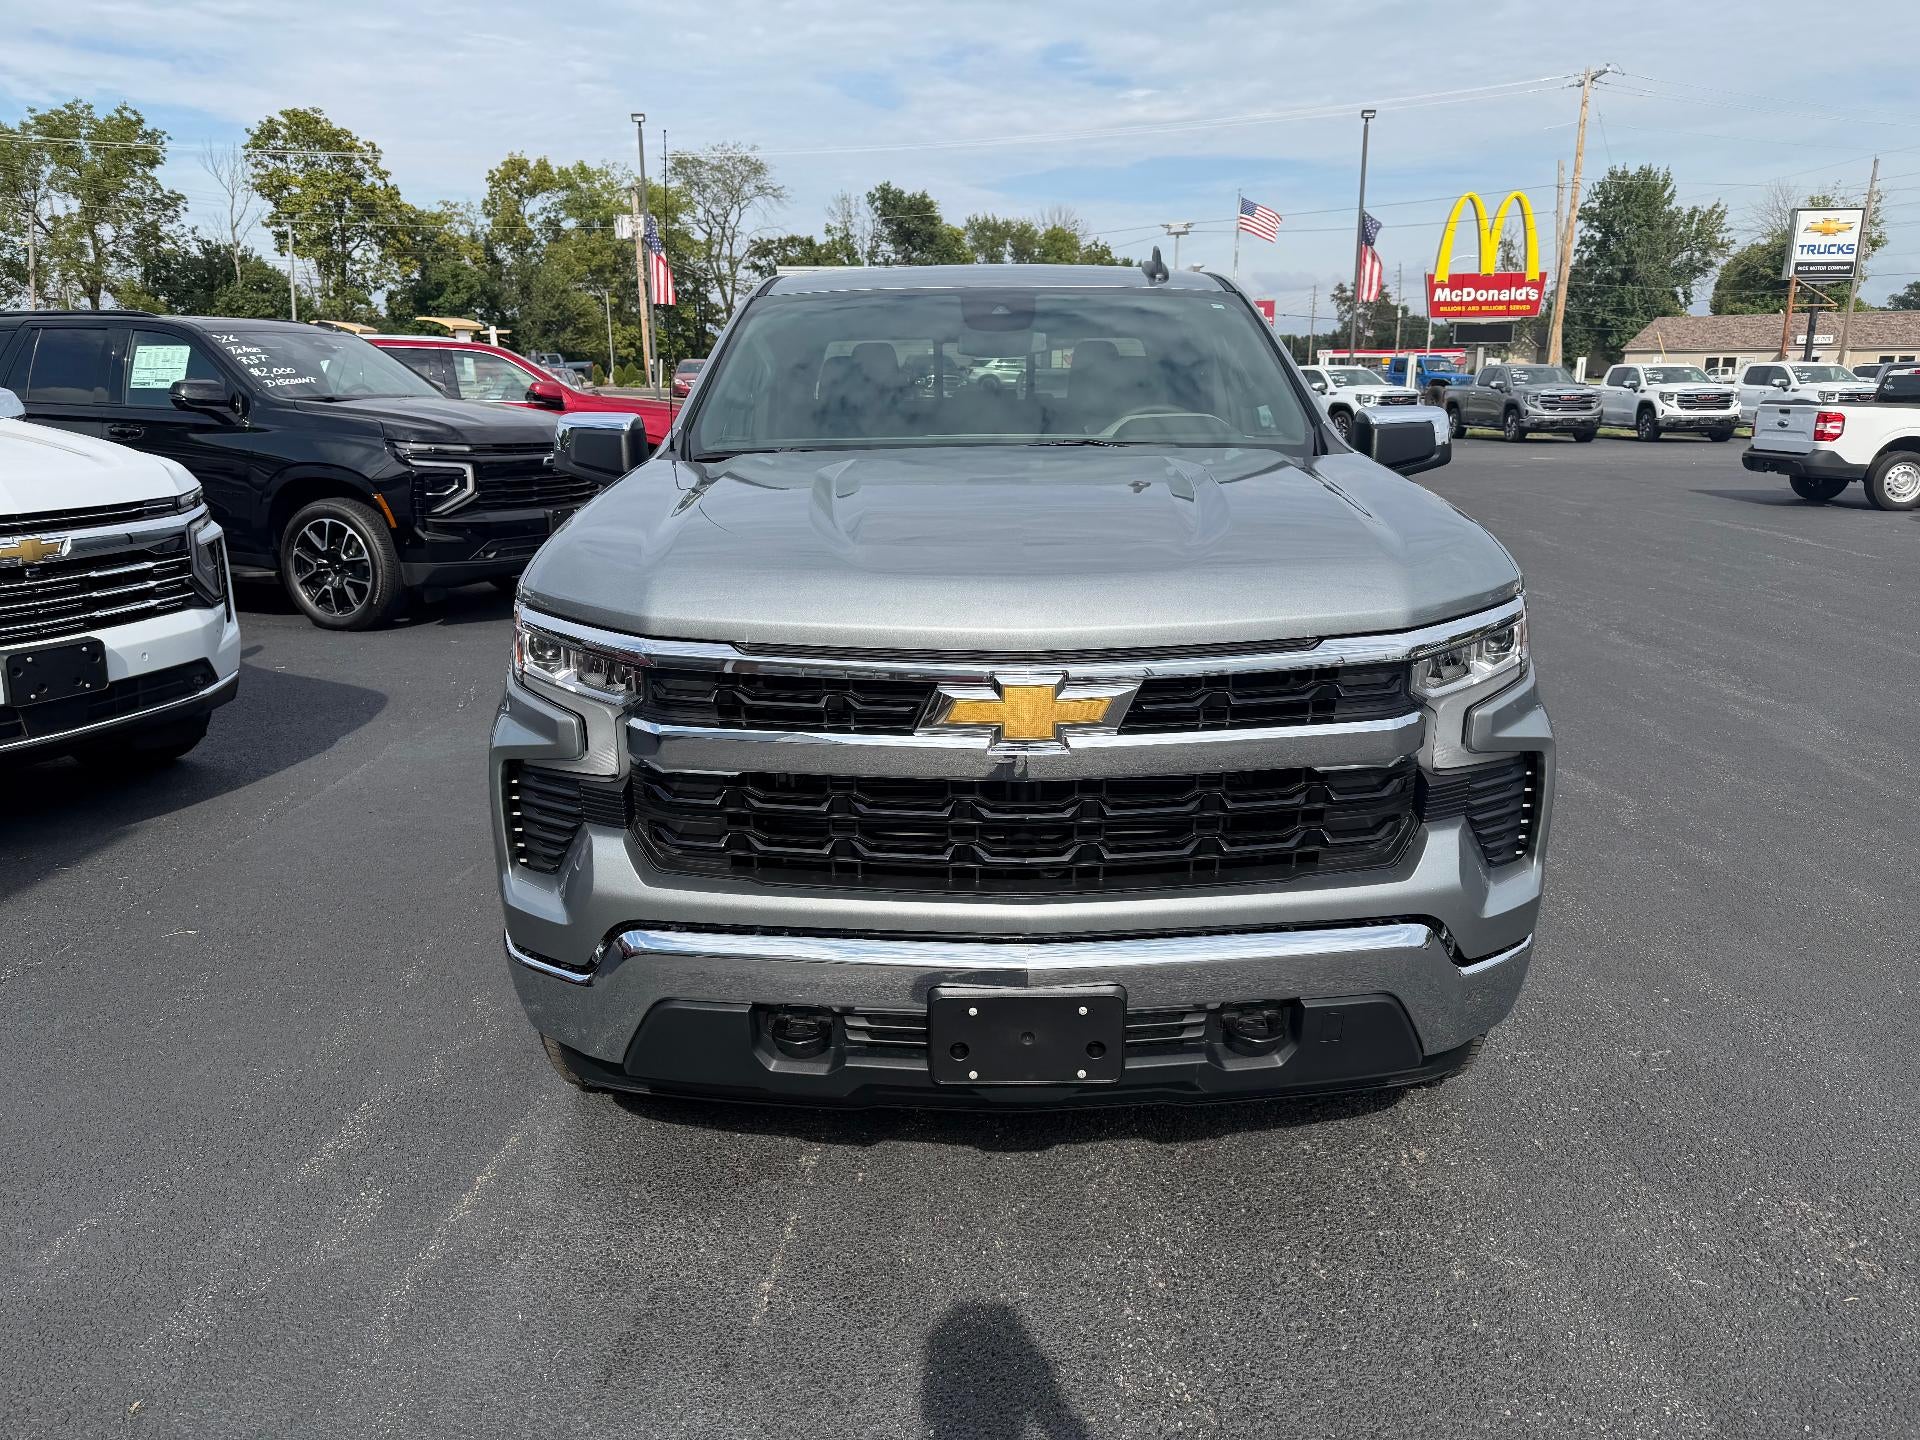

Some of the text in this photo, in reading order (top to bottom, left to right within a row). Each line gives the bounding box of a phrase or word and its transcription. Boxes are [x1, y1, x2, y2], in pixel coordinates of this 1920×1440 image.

[1798, 243, 1856, 255] TRUCKS
[1433, 287, 1539, 302] McDonald's
[237, 355, 269, 364] RST
